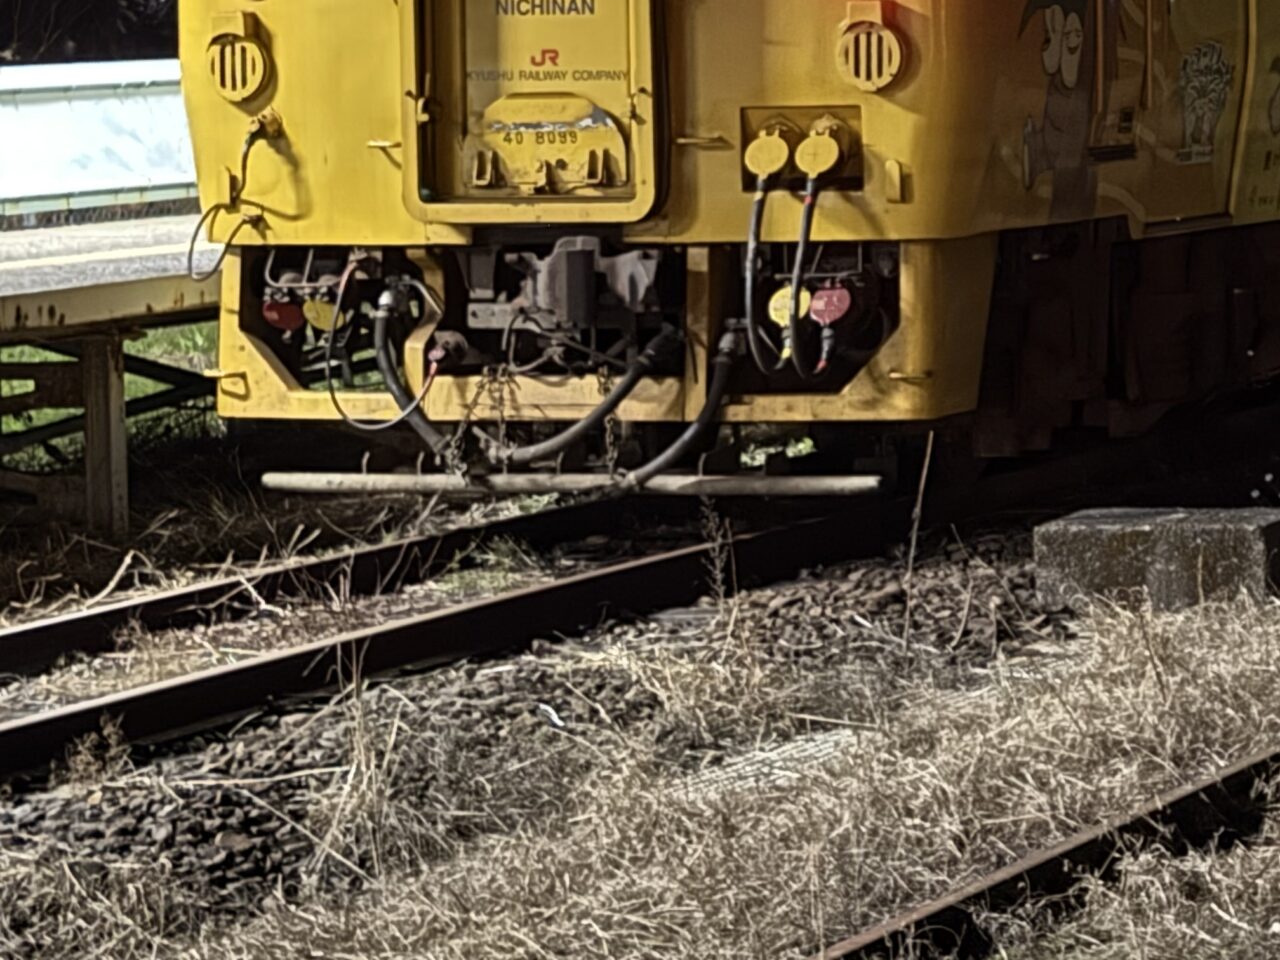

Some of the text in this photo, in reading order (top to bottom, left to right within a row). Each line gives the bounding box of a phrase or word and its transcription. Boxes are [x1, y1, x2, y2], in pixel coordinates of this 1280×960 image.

[530, 48, 560, 67] JR
[467, 69, 628, 82] KYUSHU RAILWAY COMPANY
[502, 130, 578, 145] 40 8099
